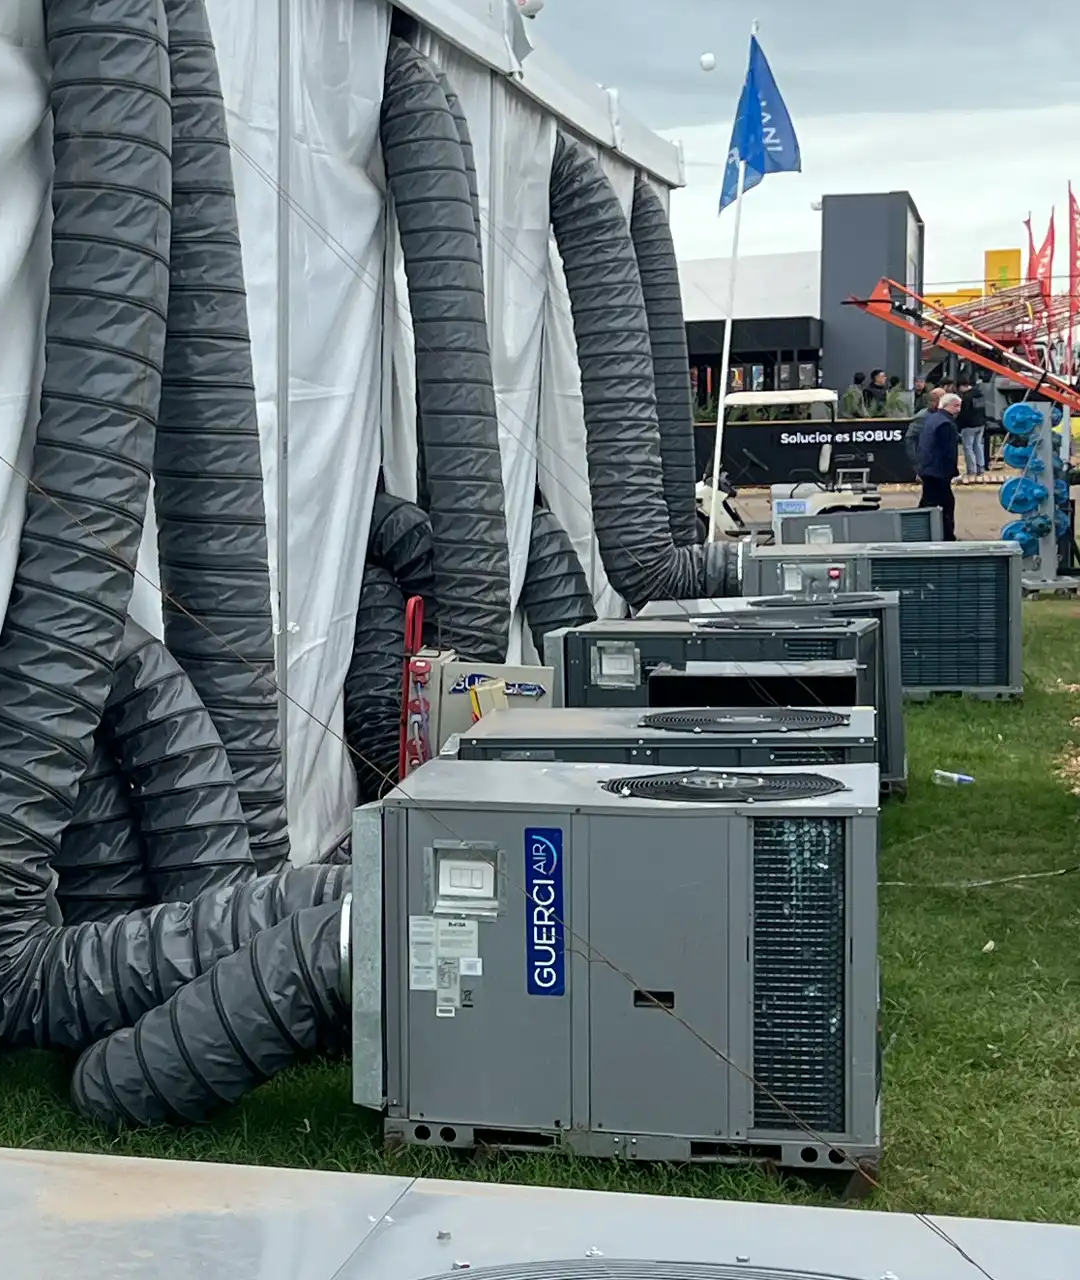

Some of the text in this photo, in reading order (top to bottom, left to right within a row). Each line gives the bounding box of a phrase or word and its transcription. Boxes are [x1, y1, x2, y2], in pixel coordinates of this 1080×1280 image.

[852, 429, 902, 442] ISOBUS
[532, 843, 557, 988] GUERCI AIR
